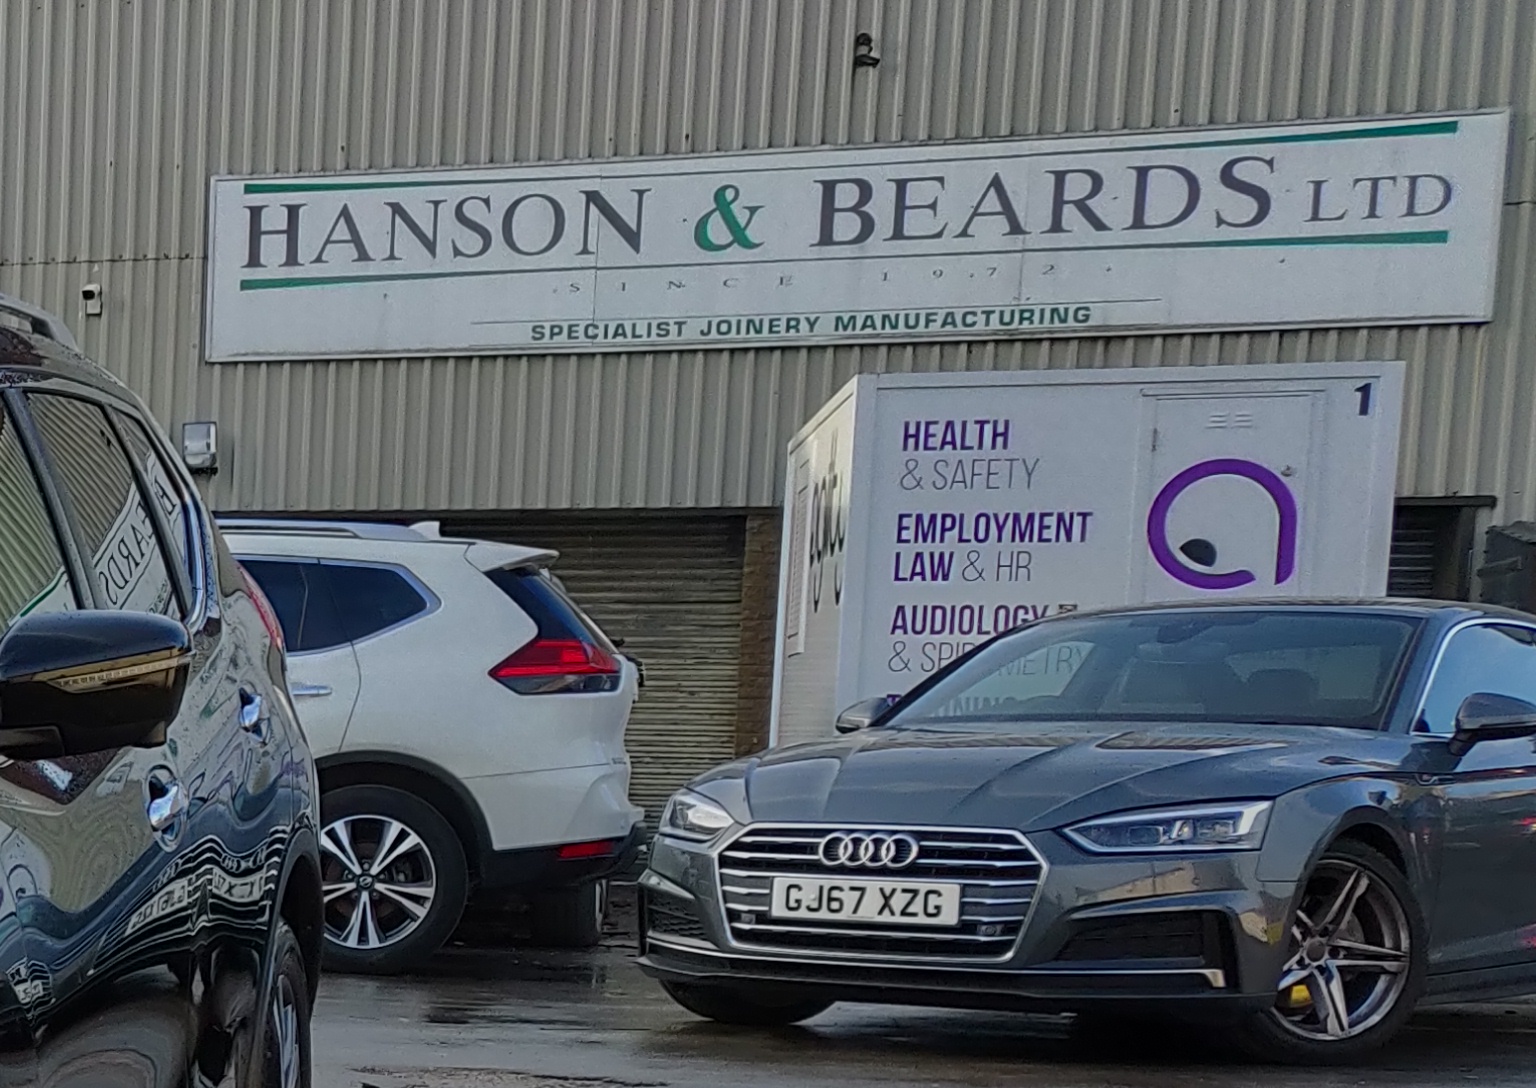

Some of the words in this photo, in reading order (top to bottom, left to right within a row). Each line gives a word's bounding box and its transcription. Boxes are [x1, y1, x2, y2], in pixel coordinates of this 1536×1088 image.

[240, 187, 653, 269] HANSON
[693, 184, 766, 252] &
[808, 155, 1276, 248] BEARDS
[1304, 173, 1454, 223] LTD
[530, 320, 688, 341] SPECIALIST
[699, 316, 821, 337] JOINERY
[833, 306, 1092, 332] MANUFACTURING
[1354, 382, 1372, 416] 1
[901, 419, 1011, 451] HEALTH
[900, 458, 924, 491] &
[931, 458, 1040, 490] SAFETY
[895, 511, 1094, 545] EMPLOYMENT
[893, 550, 955, 582] LAW
[961, 549, 986, 582] &
[995, 550, 1033, 582] HR
[888, 640, 912, 673] &
[785, 883, 867, 915] GJ67
[877, 886, 943, 918] XZG
